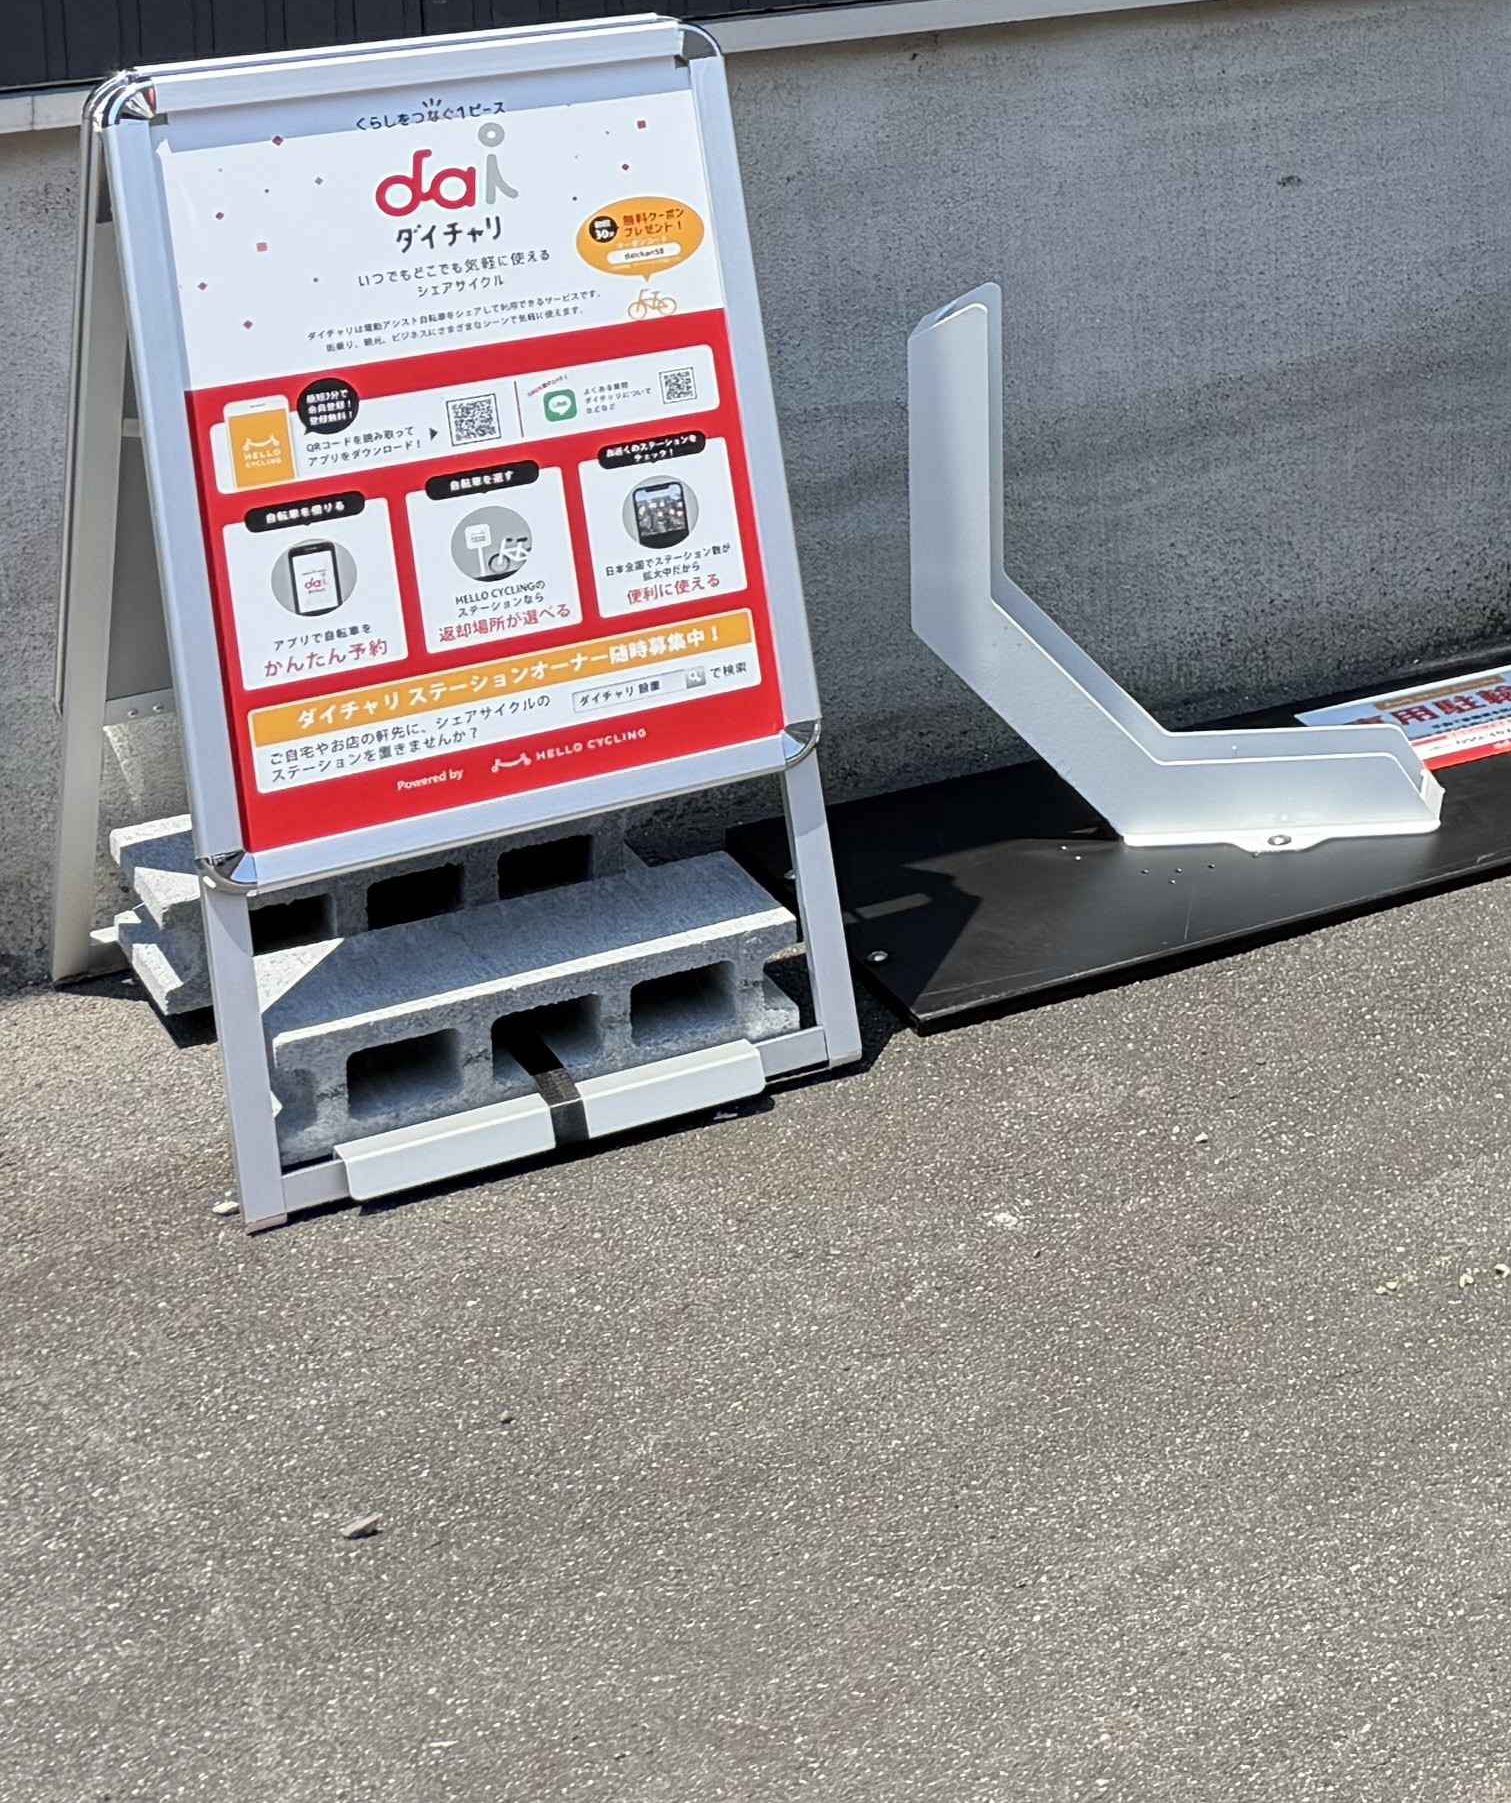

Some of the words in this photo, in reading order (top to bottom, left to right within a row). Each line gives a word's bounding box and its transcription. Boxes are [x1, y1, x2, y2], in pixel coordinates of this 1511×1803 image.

[375, 122, 519, 217] dai
[396, 216, 502, 253] ダイチャリ
[358, 249, 550, 287] いつでもどこでも気軽に使える
[417, 275, 504, 298] シェアサイクル
[306, 426, 414, 453] QRコードを読み取って
[458, 592, 545, 617] ステーションなら
[627, 573, 720, 605] 便利に使える
[274, 624, 372, 651] アプリで自転車を
[439, 604, 571, 642] 返却場所が選べる
[264, 638, 388, 678] かんたん予約
[580, 686, 634, 707] ダイチャリ
[710, 662, 748, 679] で検索
[270, 694, 550, 766] ご自宅やお店の軒先に、シェアサイクルの
[536, 742, 583, 762] HELLO
[586, 728, 647, 749] CYCLING
[271, 728, 478, 783] ステーションを置きませんか？
[396, 771, 448, 791] Powered
[449, 768, 464, 782] by
